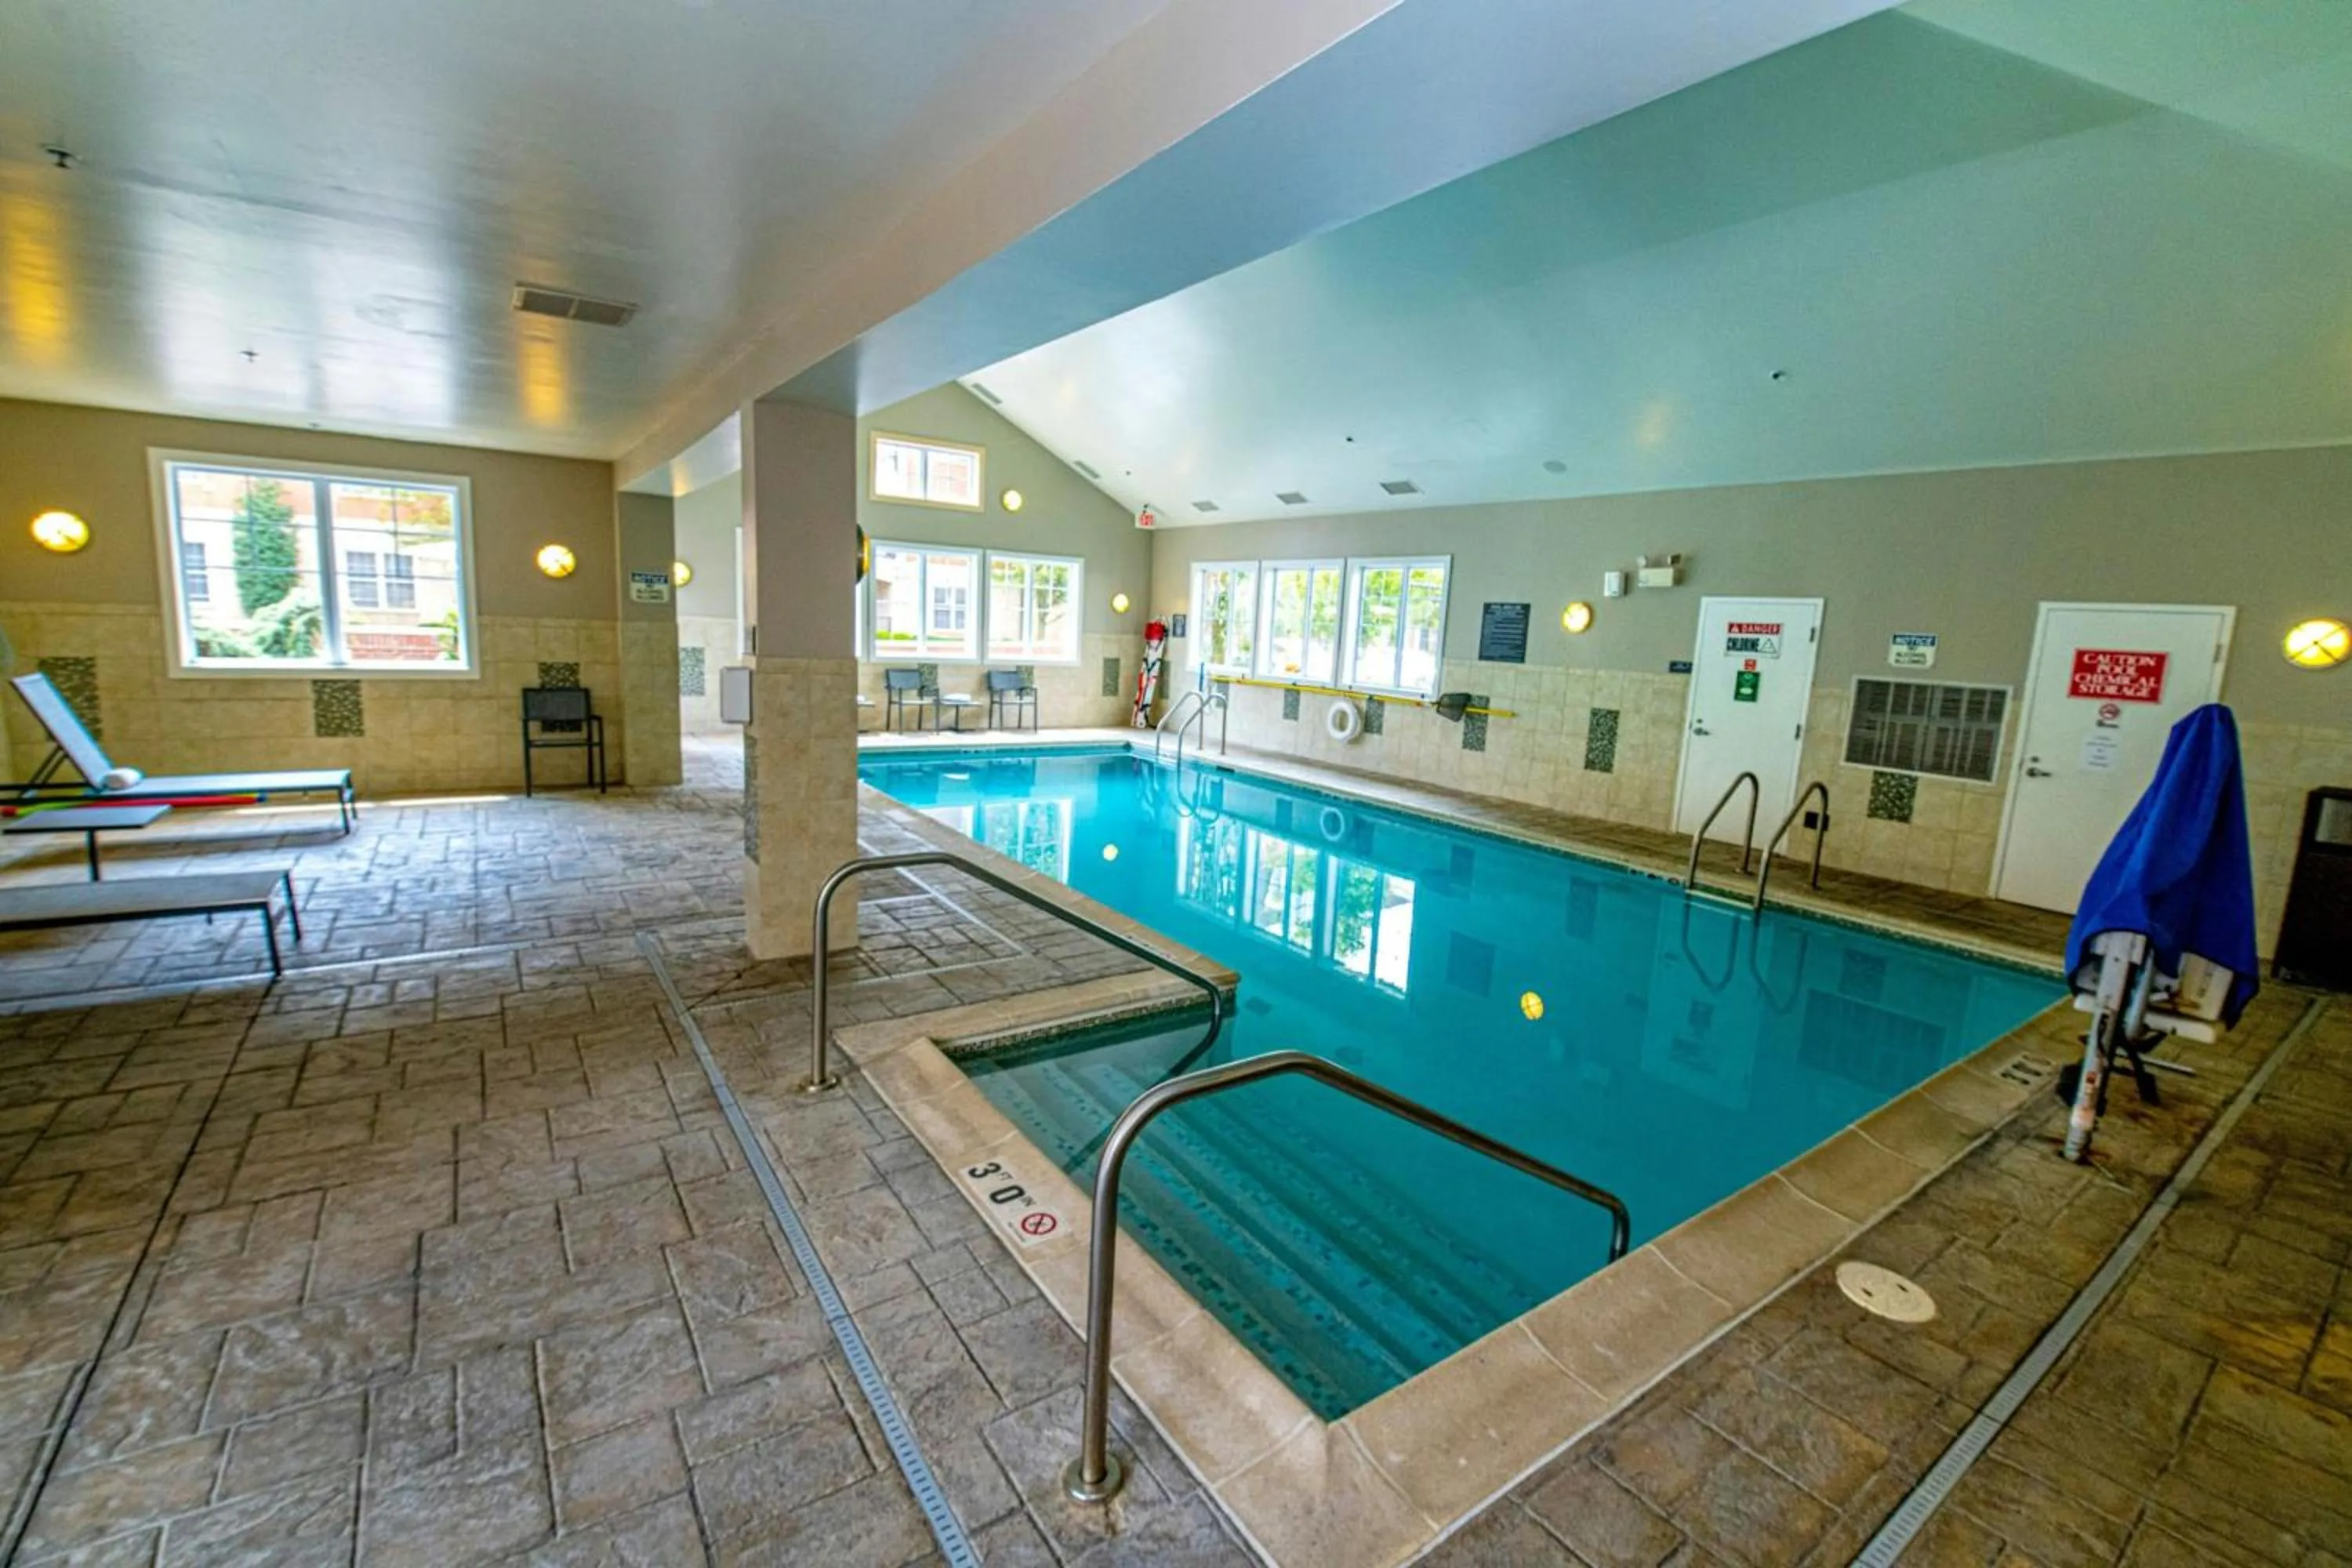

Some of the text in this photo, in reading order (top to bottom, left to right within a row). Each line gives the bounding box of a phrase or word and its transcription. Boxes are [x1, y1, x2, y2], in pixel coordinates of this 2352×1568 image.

[1742, 624, 1778, 633] DANGER
[1726, 637, 1759, 652] CHLORINE
[2082, 653, 2156, 666] CAUTION
[2096, 665, 2138, 677] POOL
[2074, 673, 2158, 688] CHEMICAL
[2078, 684, 2150, 697] STORAGE
